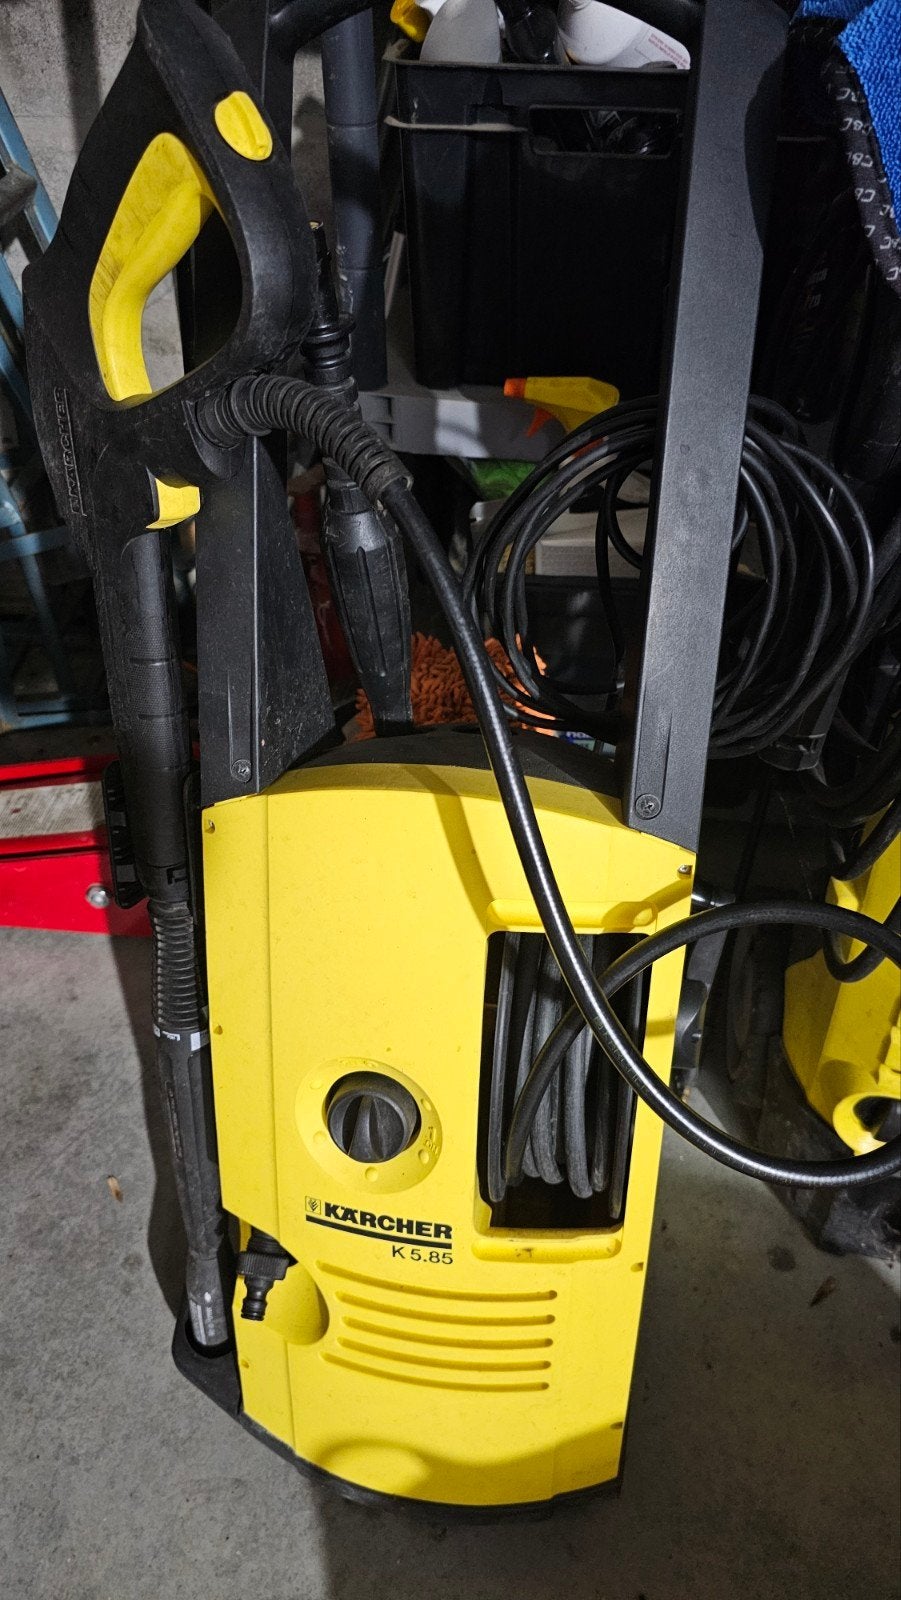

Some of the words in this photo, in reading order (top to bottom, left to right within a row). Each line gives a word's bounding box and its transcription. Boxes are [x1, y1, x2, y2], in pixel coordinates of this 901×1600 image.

[324, 1201, 453, 1239] KÄRCHER
[392, 1245, 406, 1259] K
[410, 1248, 454, 1265] 5.85
